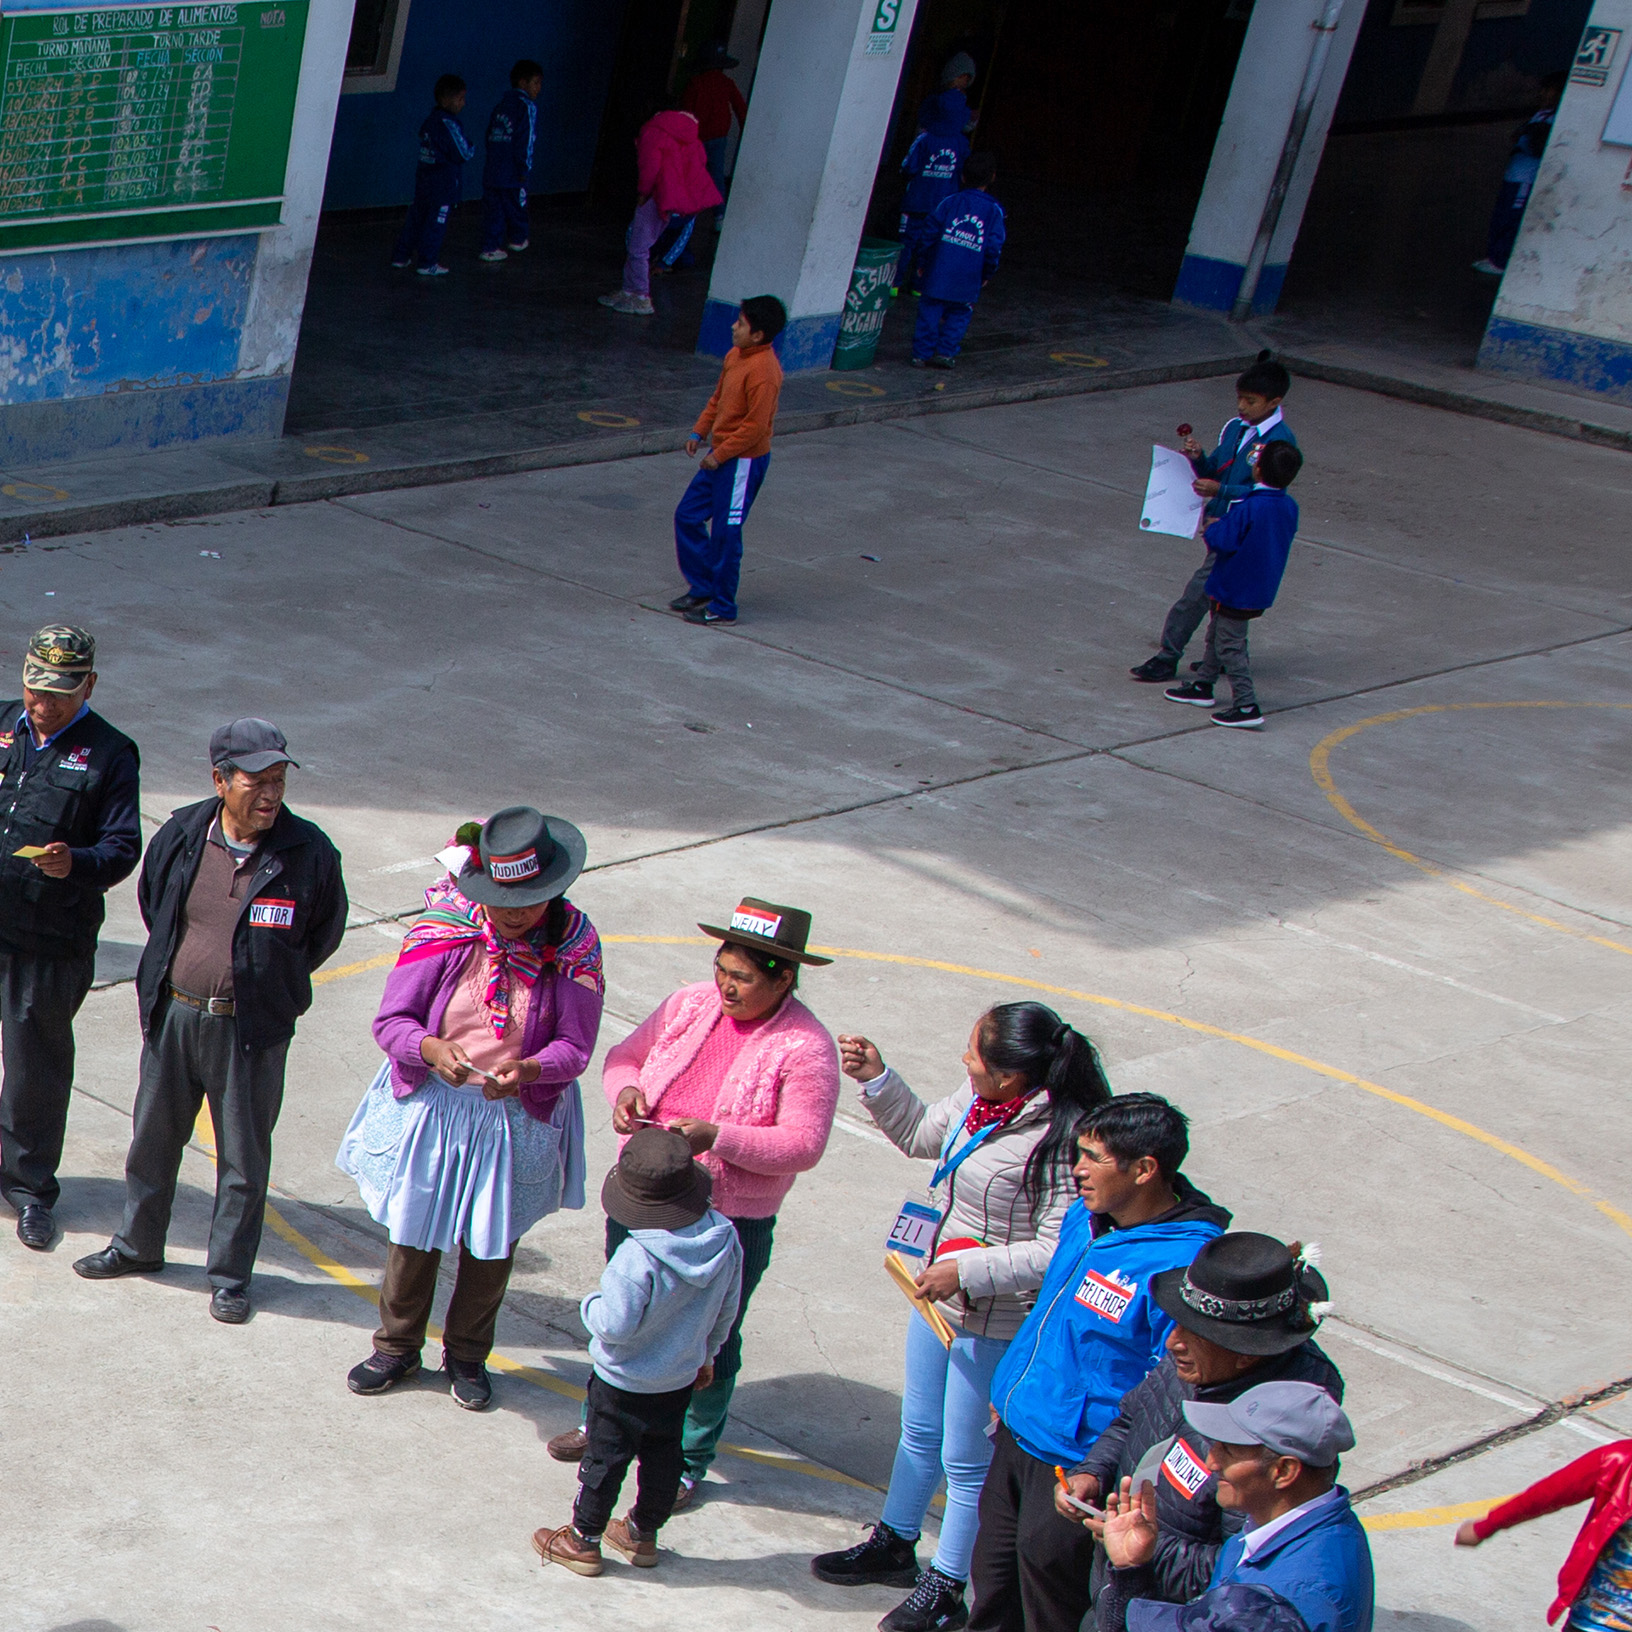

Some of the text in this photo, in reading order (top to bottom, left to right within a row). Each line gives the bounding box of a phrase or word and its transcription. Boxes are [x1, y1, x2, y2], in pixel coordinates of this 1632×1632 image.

[74, 13, 88, 29] DE
[92, 10, 154, 29] PREPARADO
[160, 9, 172, 25] DE
[178, 5, 238, 23] ALIMENTOS
[152, 31, 220, 47] TURNO TARDE
[37, 42, 68, 55] TURNO
[137, 51, 170, 64] FECHA
[16, 62, 47, 75] FECHA
[250, 905, 288, 923] VICTOR
[734, 917, 773, 935] NELLY
[889, 1215, 924, 1244] ELI
[1076, 1278, 1129, 1316] MELCHOR
[1167, 1445, 1206, 1491] ANTONIO
